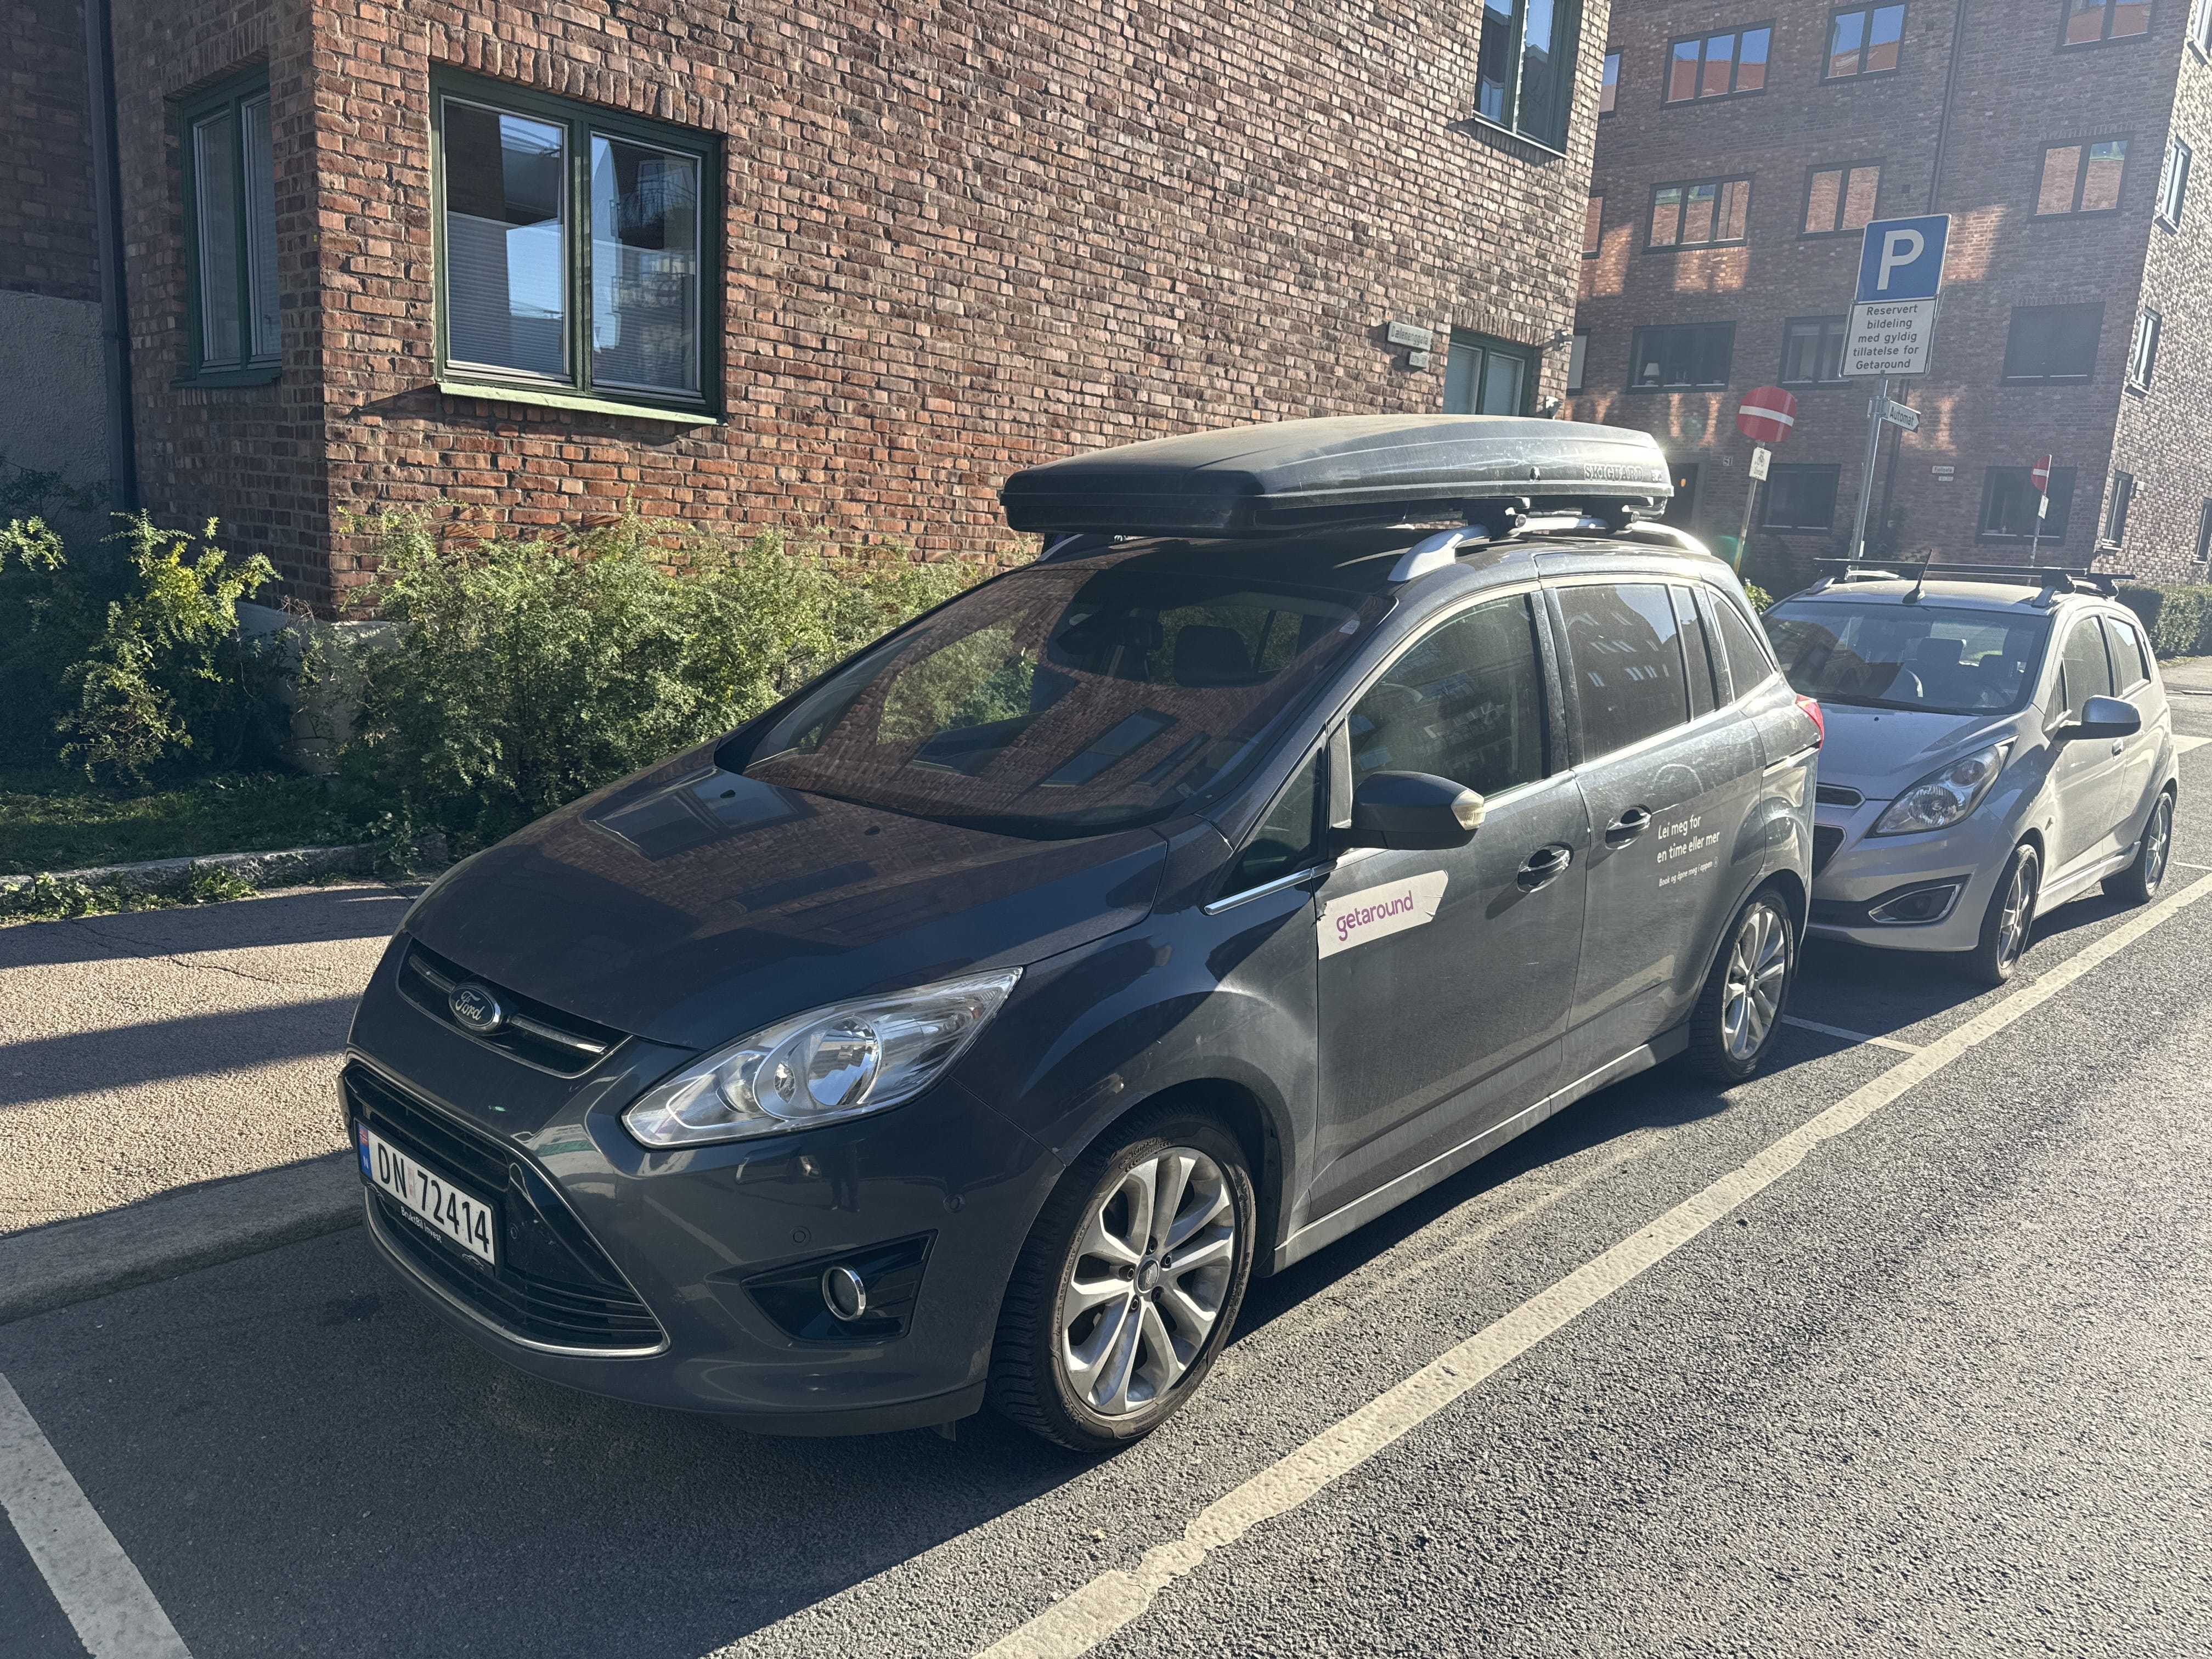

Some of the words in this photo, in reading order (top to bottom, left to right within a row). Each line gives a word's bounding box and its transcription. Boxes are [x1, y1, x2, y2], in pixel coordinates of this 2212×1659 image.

[1877, 229, 1925, 290] P
[1866, 304, 1918, 316] Reservert
[1867, 319, 1912, 329] bildeling
[1858, 334, 1880, 343] med
[1884, 332, 1917, 344] gyldig
[1853, 346, 1899, 357] tillatelse
[1904, 345, 1919, 354] for
[1856, 359, 1911, 370] Getaround
[1889, 407, 1914, 426] Automat
[1724, 457, 1732, 466] 51
[1584, 465, 1643, 481] SKIGUARD
[1658, 822, 1670, 840] Lei
[1671, 820, 1688, 836] meg
[1690, 814, 1701, 829] for
[1657, 851, 1667, 864] en
[1669, 843, 1687, 859] time
[1689, 836, 1705, 852] eller
[1706, 832, 1720, 846] mer
[1658, 876, 1670, 887] Book
[1671, 874, 1677, 884] og
[1688, 867, 1697, 876] meg
[1700, 861, 1713, 872] appen
[1336, 890, 1414, 941] getaround
[455, 991, 485, 1020] Ford
[363, 1155, 369, 1169] N
[377, 1142, 407, 1199] DN
[417, 1170, 489, 1254] 72414
[401, 1206, 423, 1229] BruktBil
[424, 1222, 442, 1243] Invest
